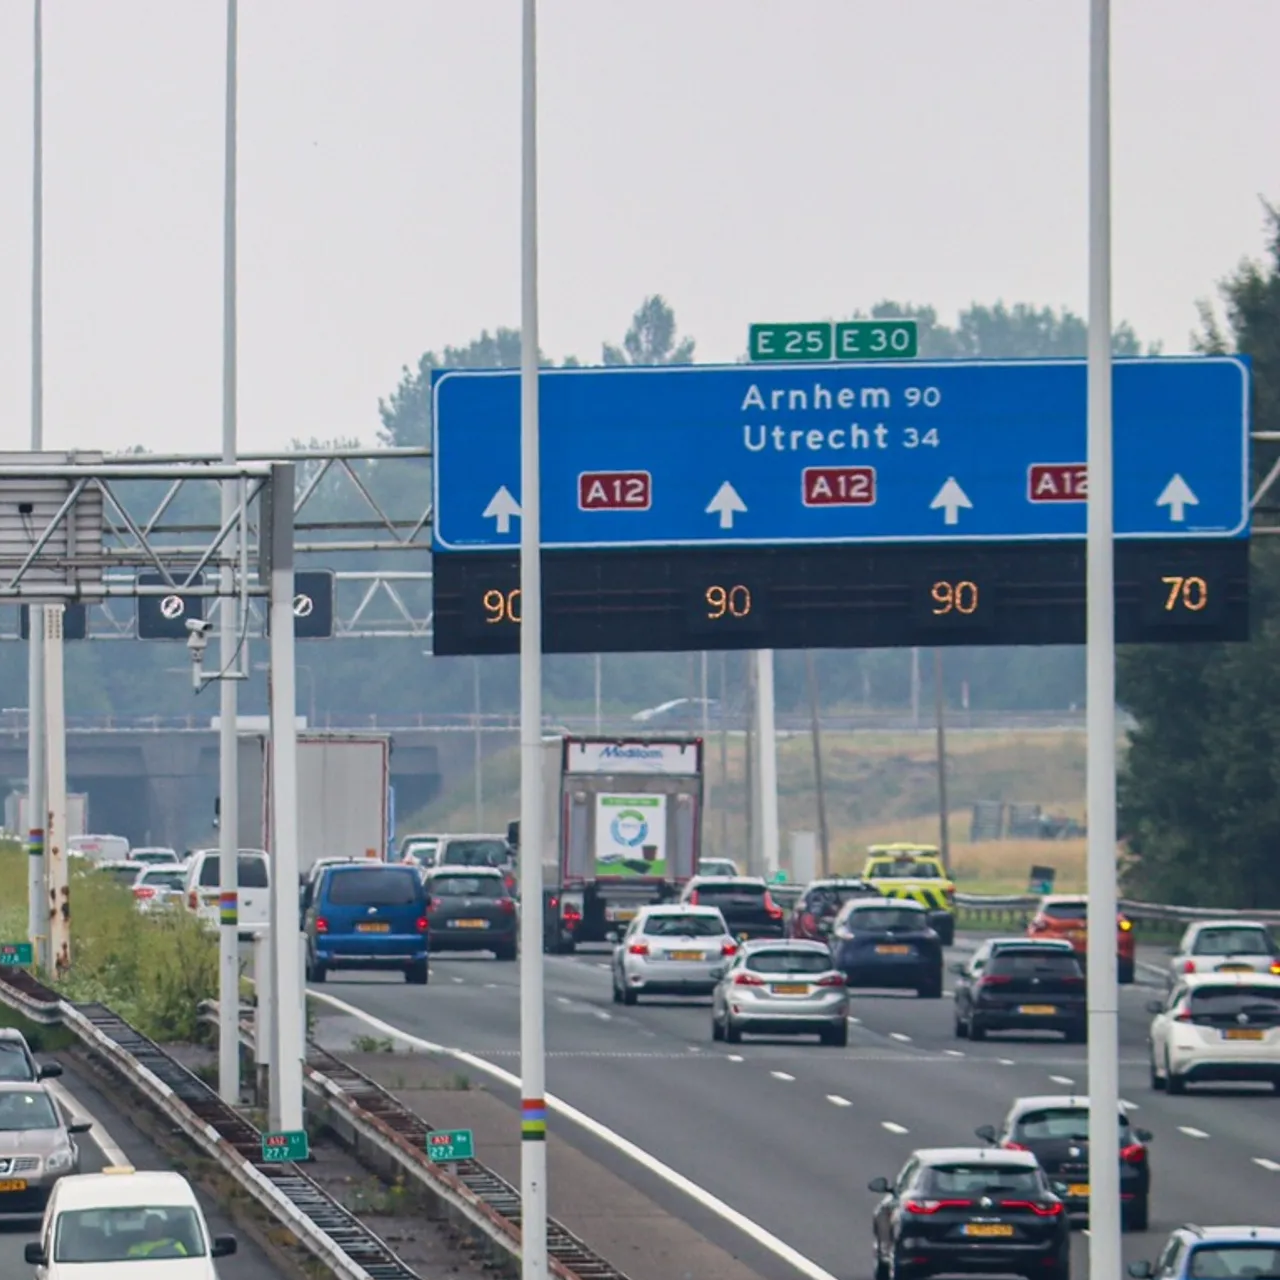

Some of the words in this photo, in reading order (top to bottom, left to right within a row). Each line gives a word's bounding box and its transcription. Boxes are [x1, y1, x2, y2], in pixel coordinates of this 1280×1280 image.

[758, 331, 774, 354] E
[784, 330, 823, 353] 25
[842, 330, 859, 352] E
[869, 328, 910, 352] 30
[741, 384, 890, 411] Arnhem
[904, 387, 941, 408] 90
[743, 424, 888, 451] Utrecht
[903, 427, 940, 449] 34
[586, 480, 645, 503] A12
[810, 475, 869, 499] A12
[1035, 472, 1088, 496] A12
[705, 585, 751, 619] 90
[930, 581, 979, 615] 90
[1161, 576, 1208, 610] 70
